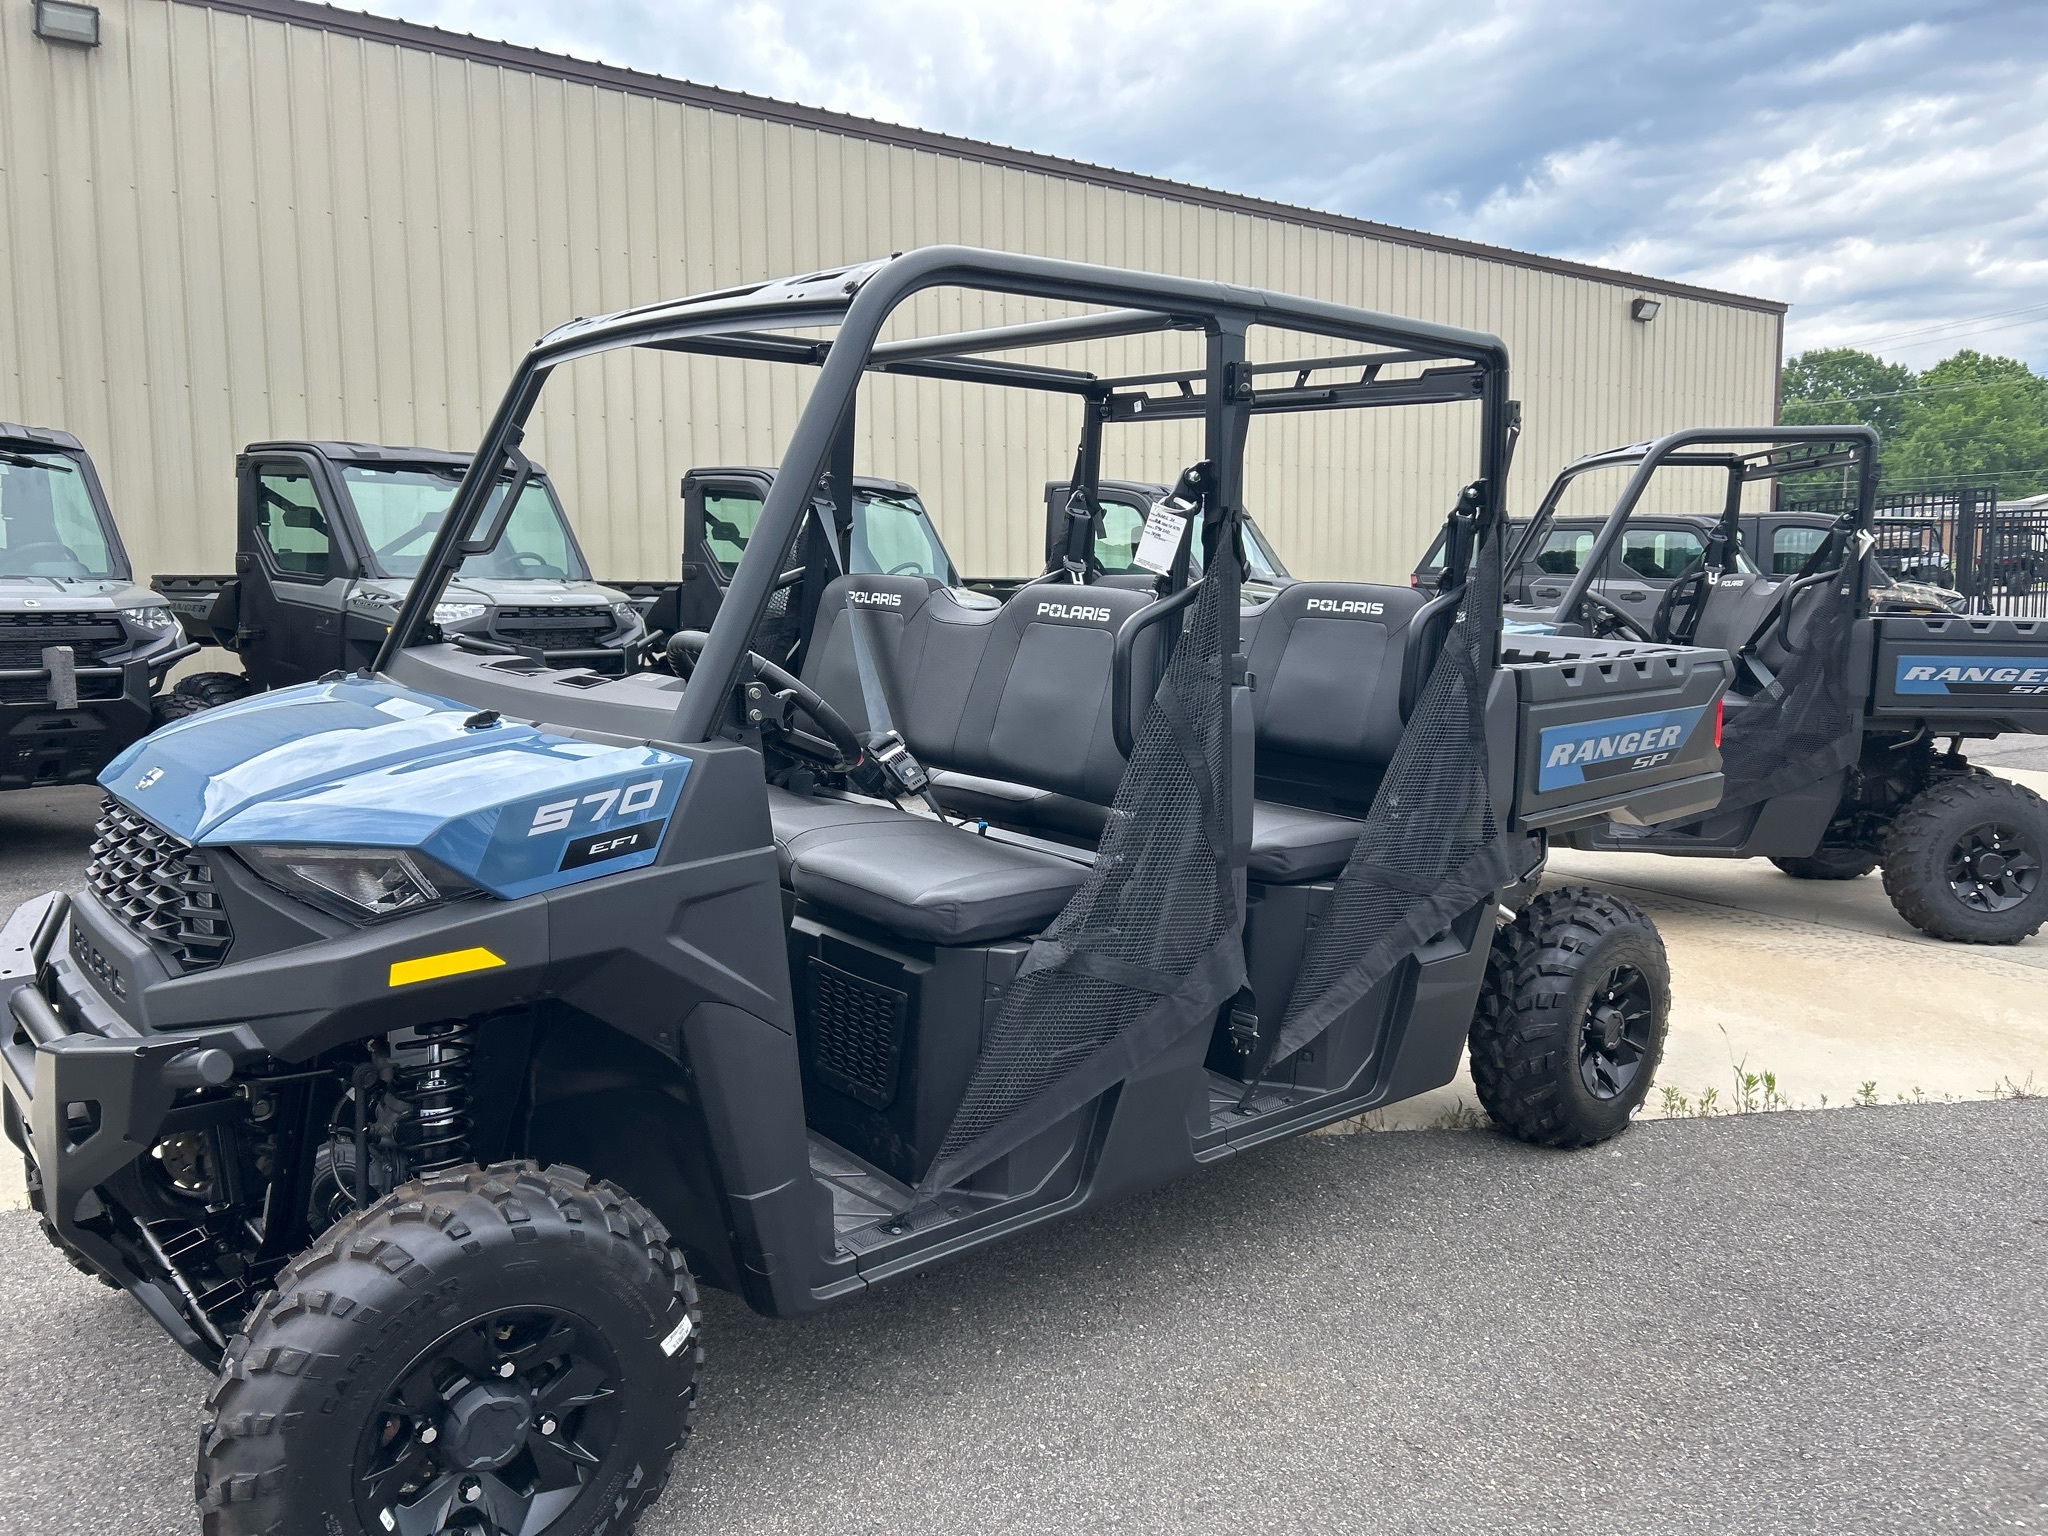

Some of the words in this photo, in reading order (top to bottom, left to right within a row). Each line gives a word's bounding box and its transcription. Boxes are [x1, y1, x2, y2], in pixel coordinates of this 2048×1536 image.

[1720, 579, 1745, 588] POLARIS
[357, 590, 391, 601] XP
[171, 602, 207, 613] ANGER
[355, 601, 381, 609] 1000
[1036, 602, 1112, 622] POLARIS
[1306, 598, 1384, 615] POLARIS
[1903, 666, 2048, 683] RANGE
[1546, 725, 1682, 769] RANGER
[1631, 752, 1670, 770] SP
[527, 779, 664, 837] 570
[588, 834, 639, 855] EFI
